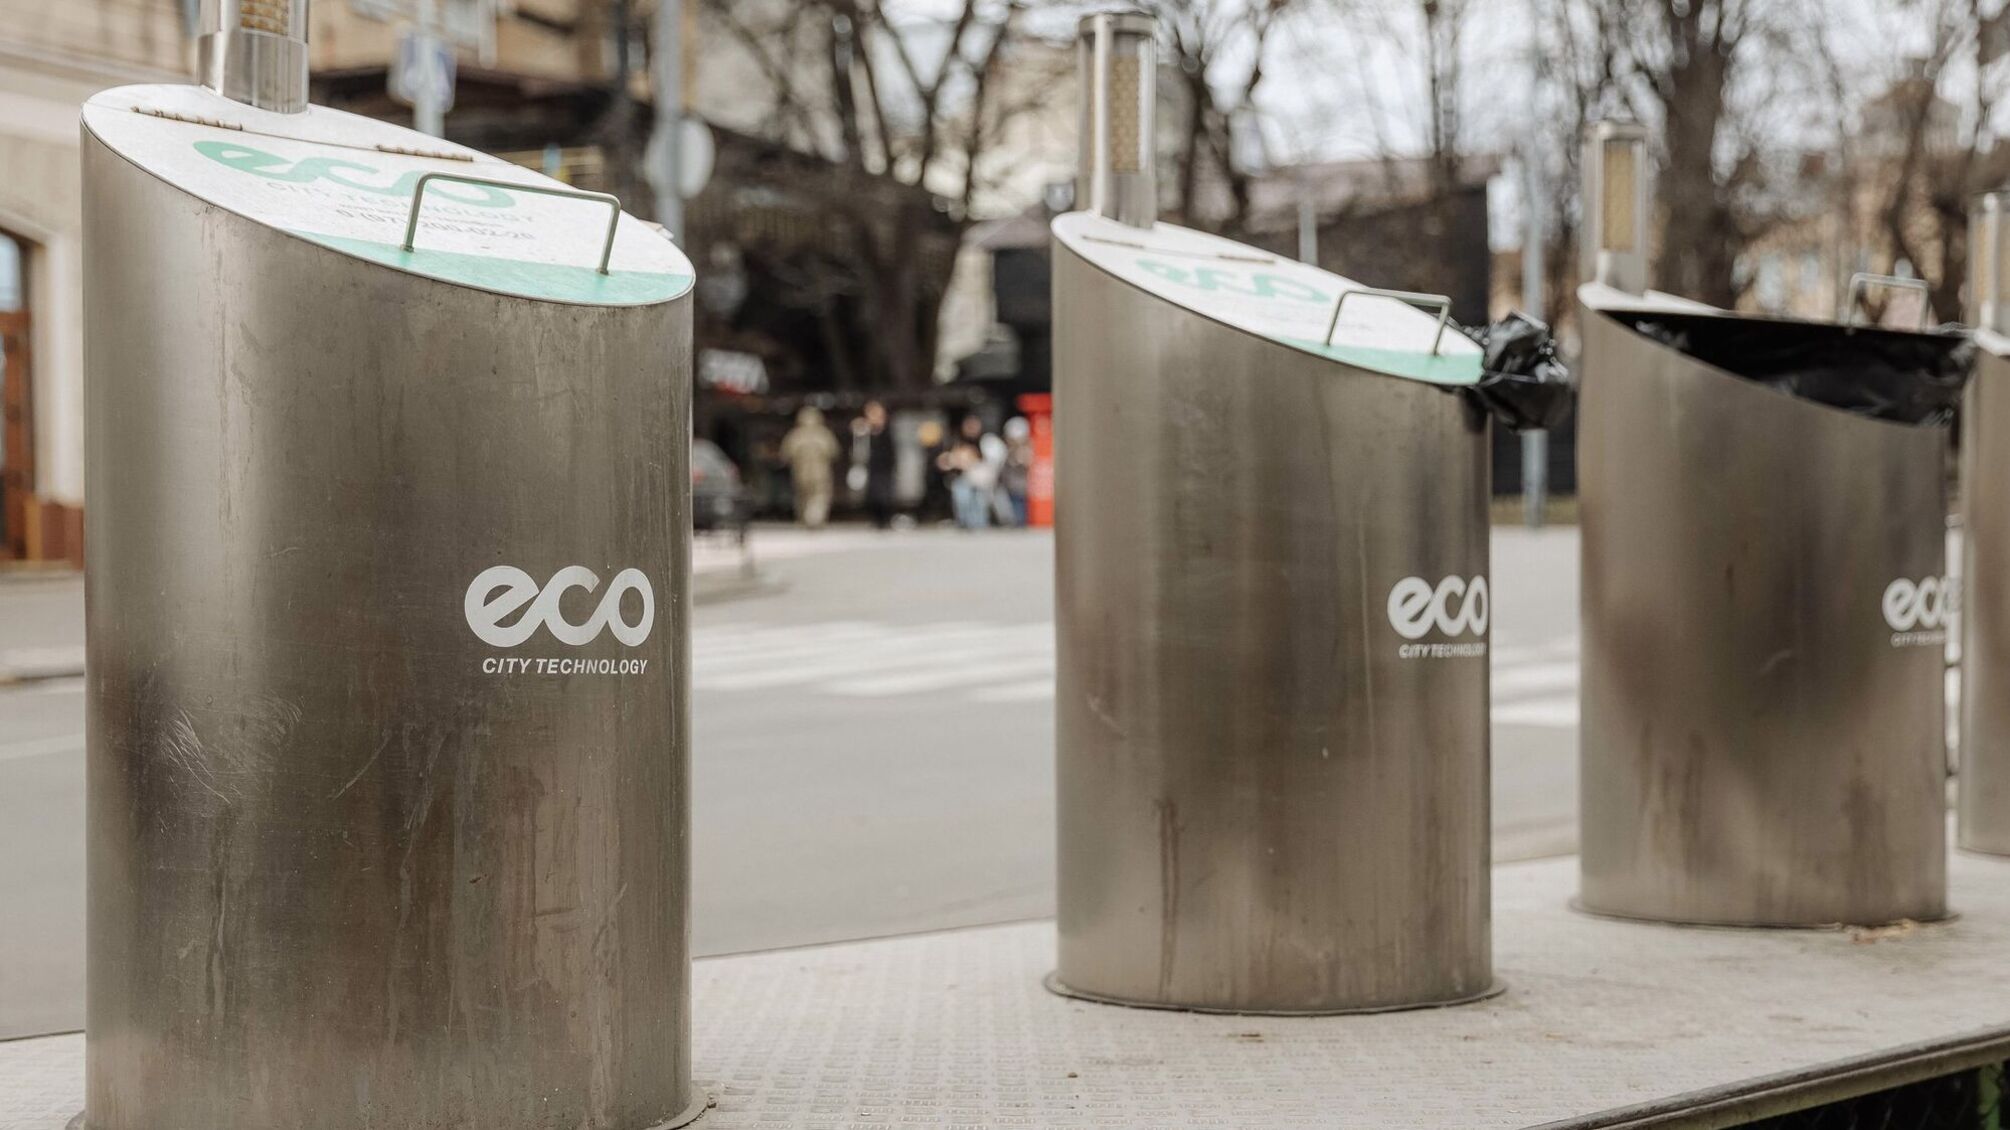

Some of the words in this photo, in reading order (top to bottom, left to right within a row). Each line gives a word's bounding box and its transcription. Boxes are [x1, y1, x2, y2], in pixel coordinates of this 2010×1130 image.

[193, 141, 516, 207] eco
[464, 565, 655, 648] eco
[1387, 574, 1489, 639] eco
[482, 657, 532, 675] CITY
[535, 658, 648, 675] TECHNOLOGY
[1399, 642, 1430, 659] CITY
